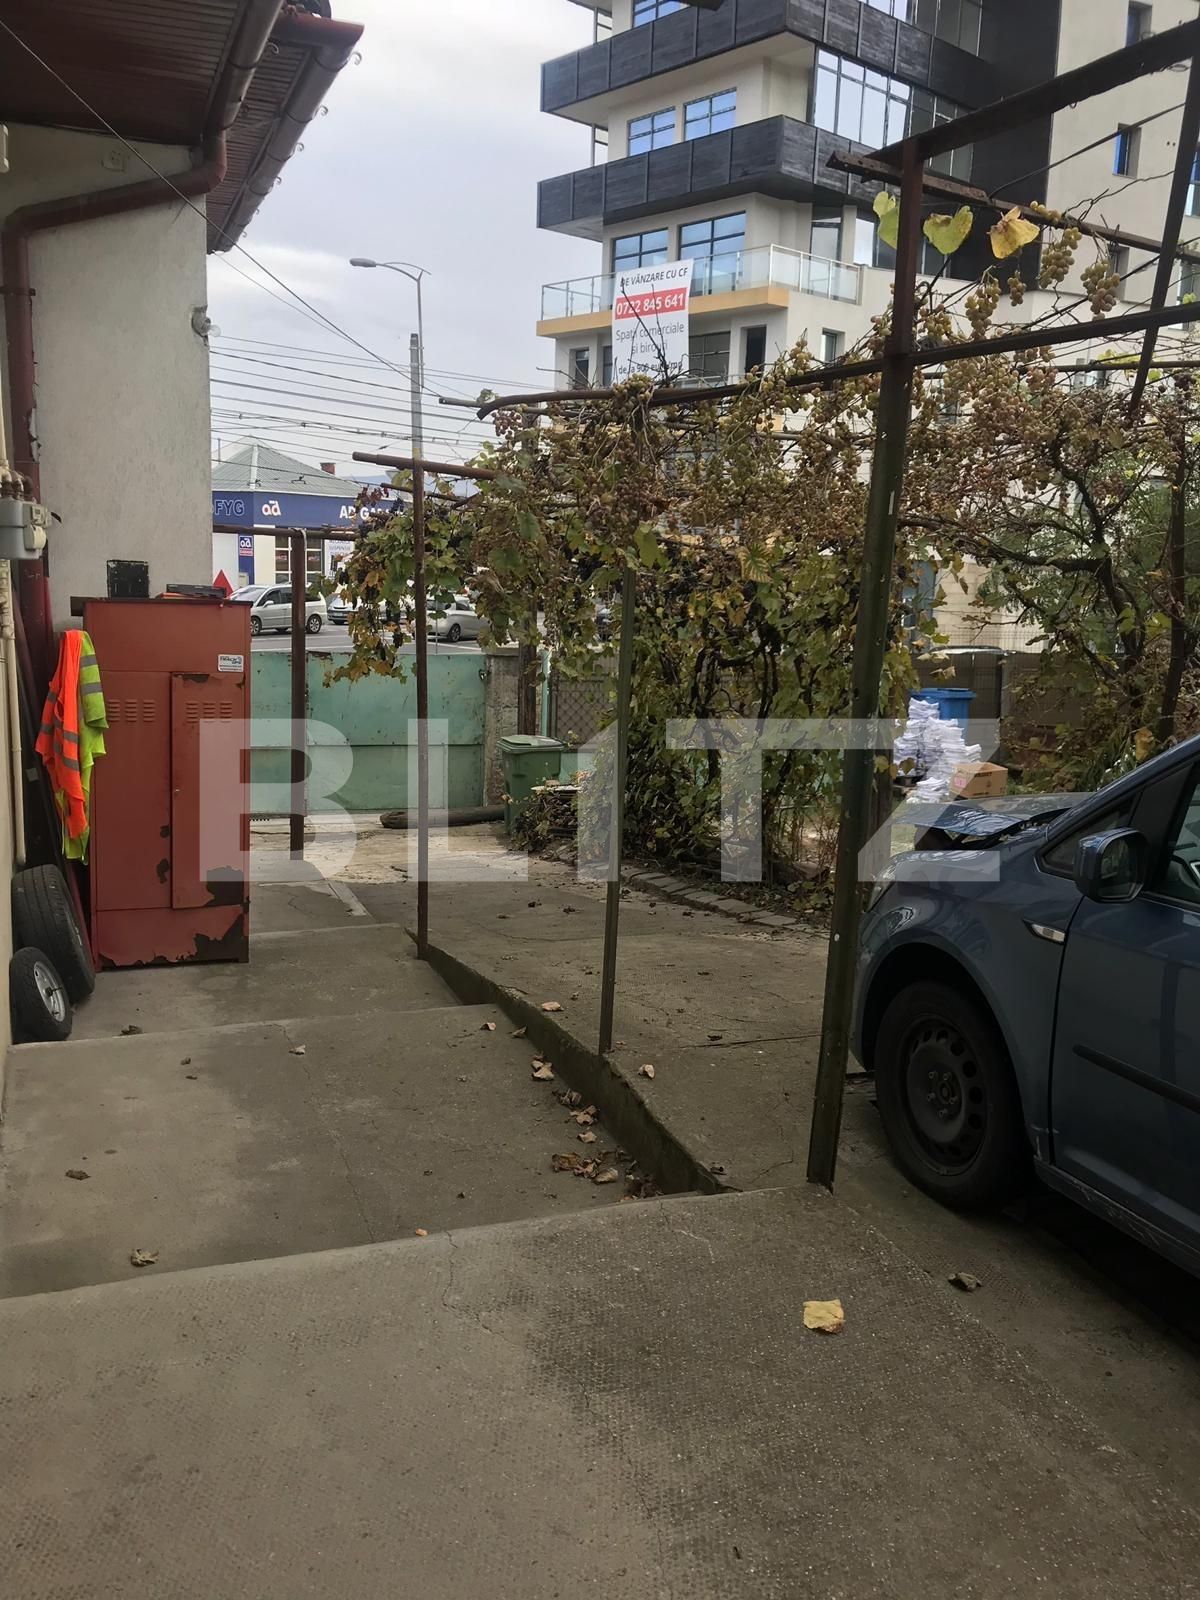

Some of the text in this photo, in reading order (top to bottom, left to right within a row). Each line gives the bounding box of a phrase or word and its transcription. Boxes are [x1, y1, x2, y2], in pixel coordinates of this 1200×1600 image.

[631, 271, 664, 286] VÂNZARE
[666, 270, 677, 279] CU
[679, 268, 688, 277] CF
[617, 293, 684, 316] 0722 845 641
[211, 499, 244, 516] FYG
